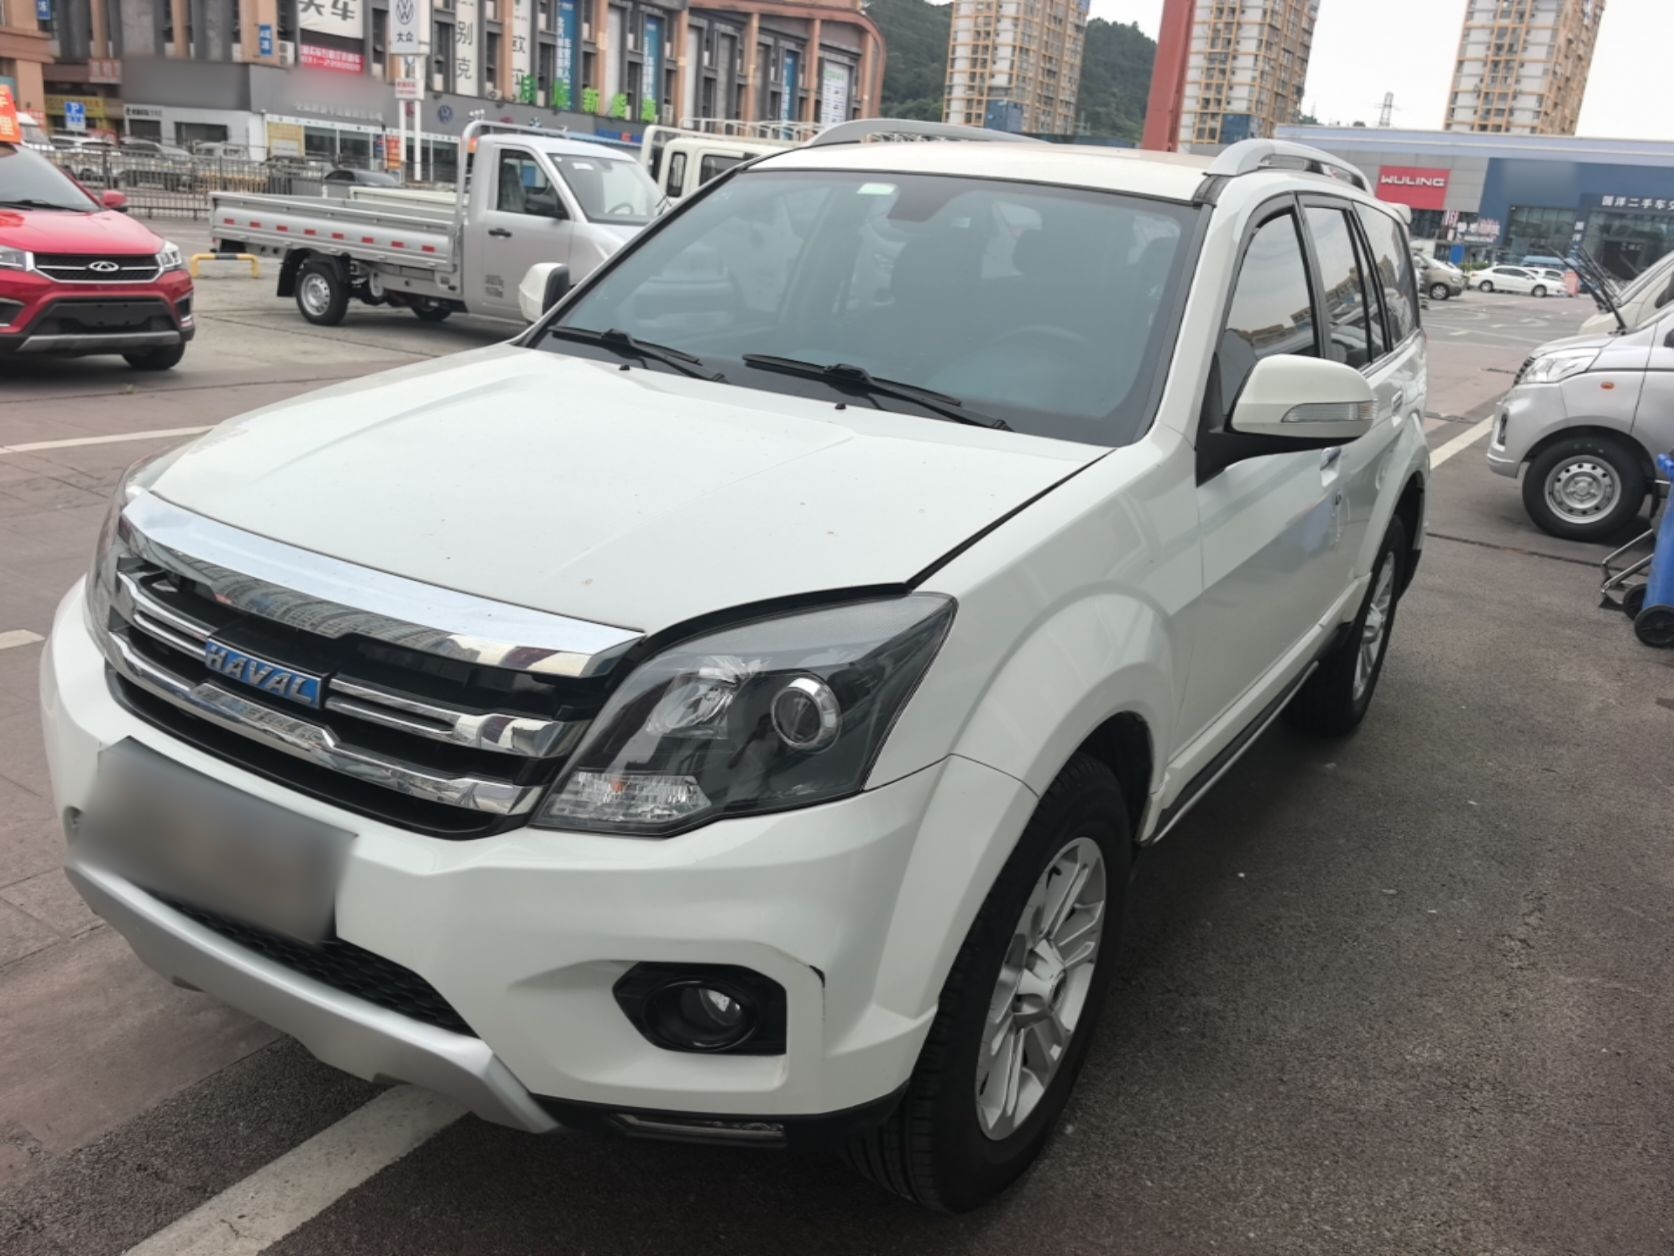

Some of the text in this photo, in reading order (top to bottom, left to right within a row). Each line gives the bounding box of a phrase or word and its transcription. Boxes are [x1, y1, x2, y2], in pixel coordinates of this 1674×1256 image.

[396, 31, 414, 42] 大众
[1380, 175, 1445, 187] WULING
[205, 643, 312, 704] HAVAL
